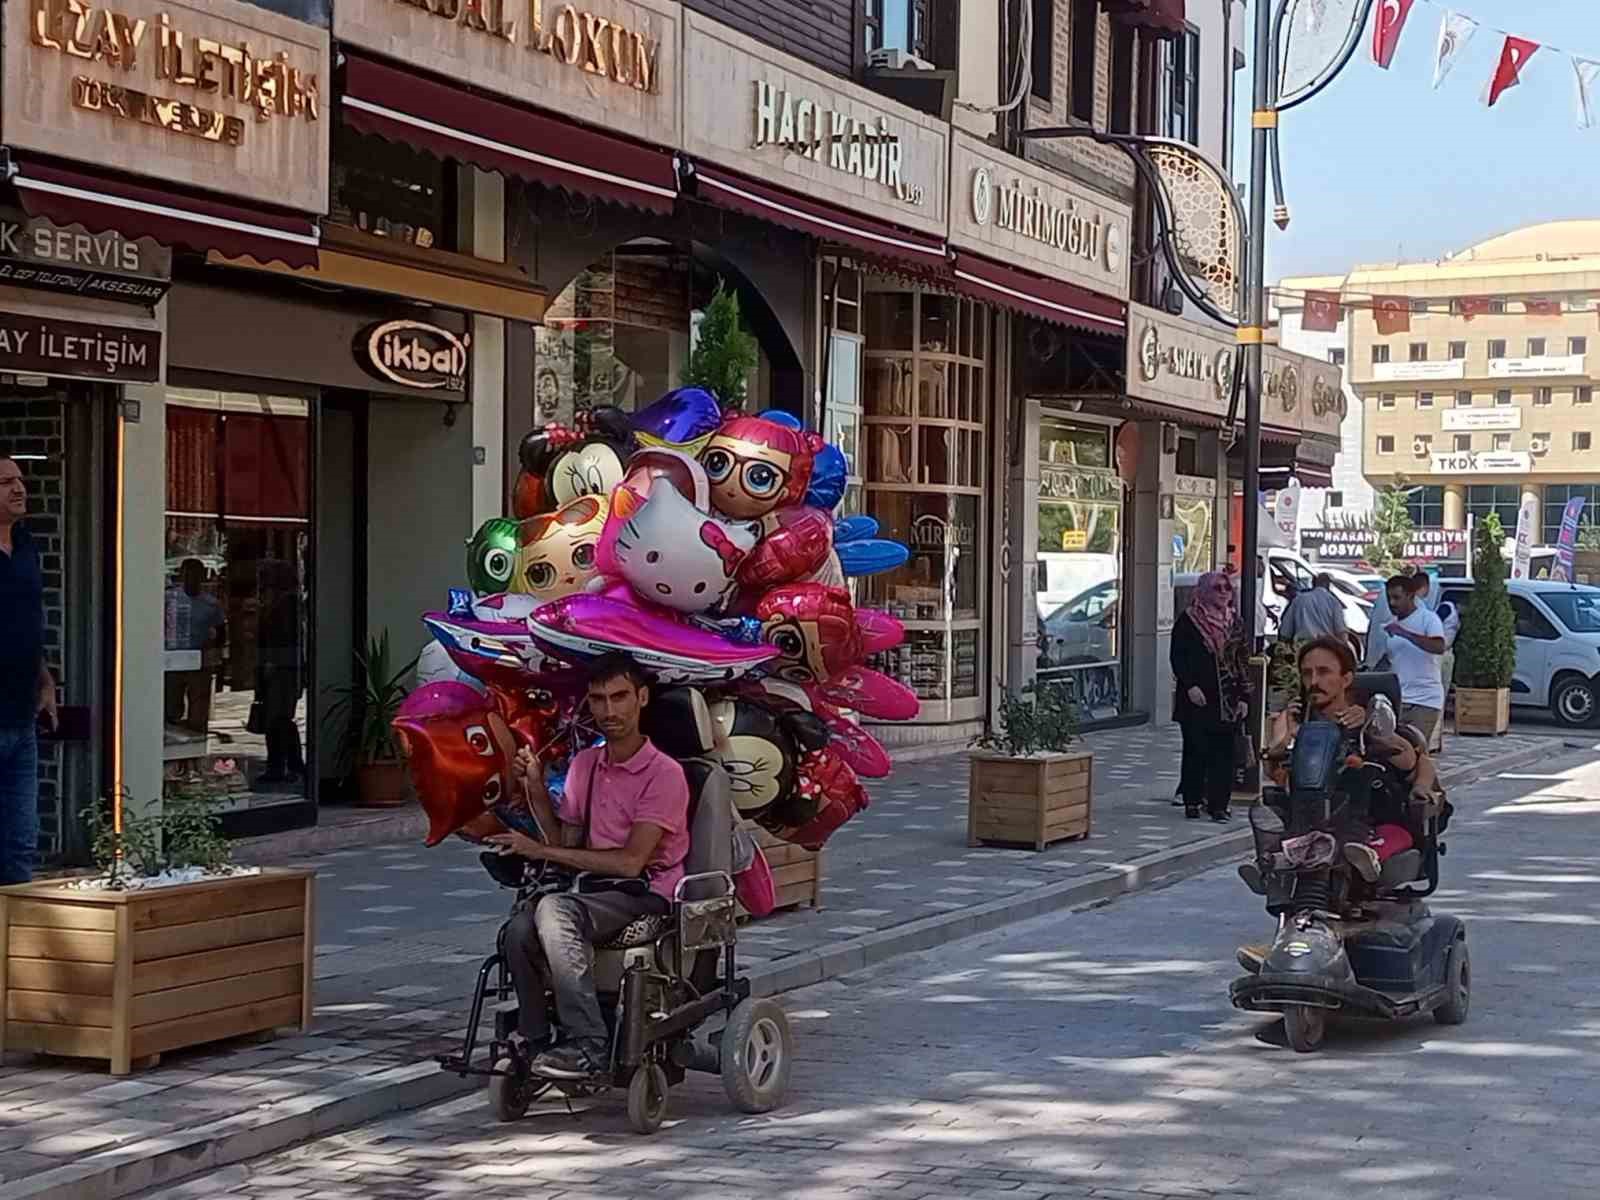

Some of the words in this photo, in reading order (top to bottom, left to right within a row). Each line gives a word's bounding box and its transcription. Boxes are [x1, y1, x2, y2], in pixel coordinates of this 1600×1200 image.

[527, 0, 661, 96] LOKUM
[825, 111, 905, 201] KADİR
[997, 178, 1102, 263] MİRİMOĞLU
[34, 228, 139, 271] SERVİS
[40, 326, 147, 374] İLETİŞİM
[382, 333, 459, 376] ikbal
[1438, 457, 1479, 471] TKDK
